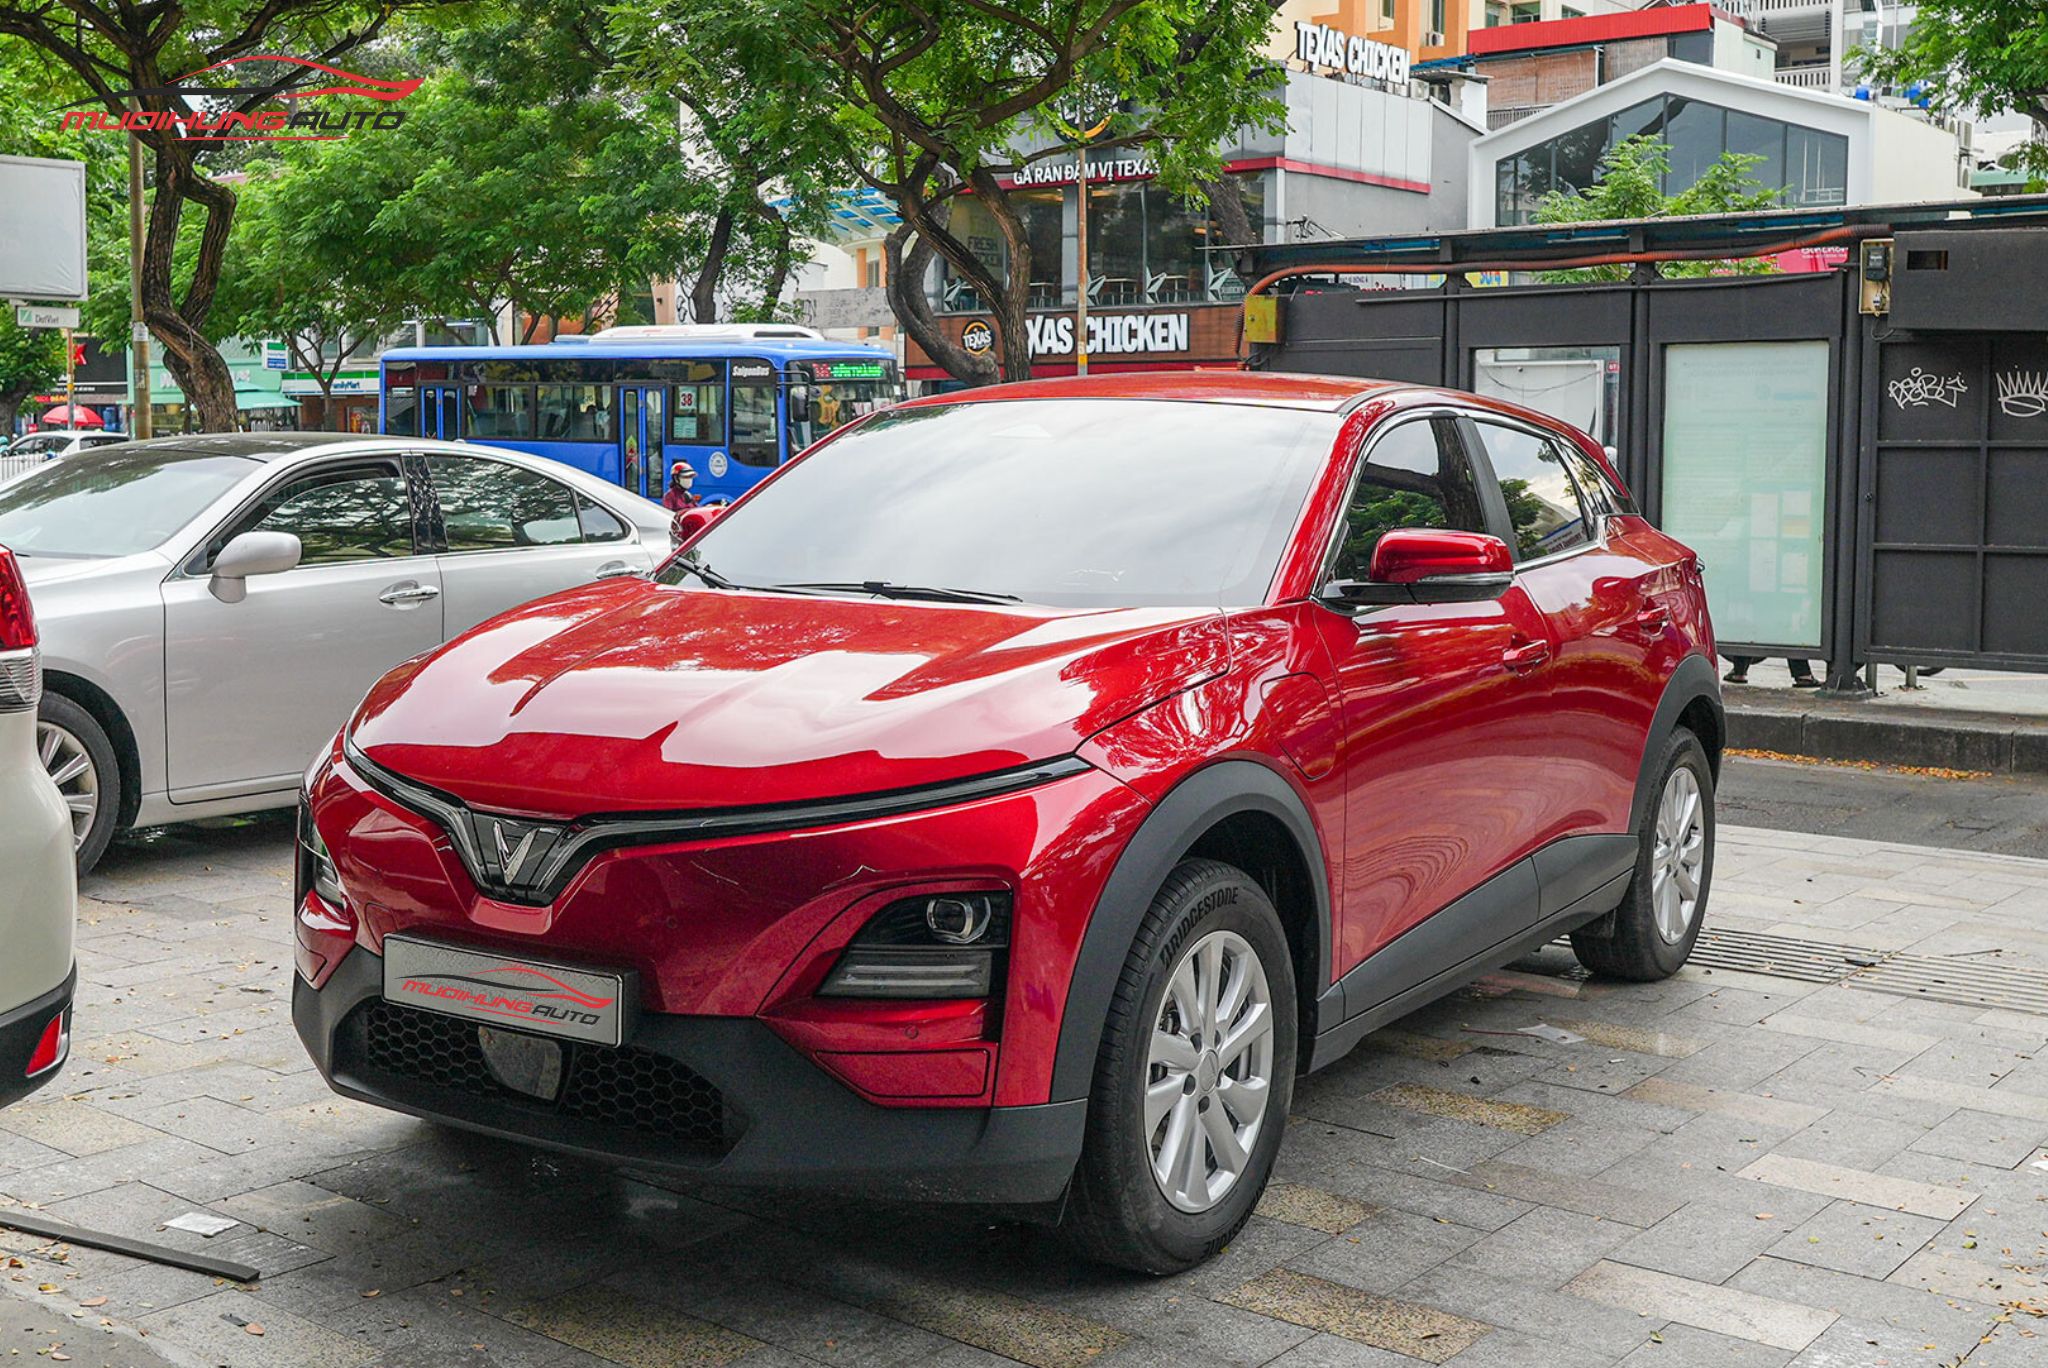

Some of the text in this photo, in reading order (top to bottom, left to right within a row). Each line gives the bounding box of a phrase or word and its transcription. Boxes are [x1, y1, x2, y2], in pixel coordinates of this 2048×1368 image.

[1296, 20, 1411, 85] TEXAS CHICKEN
[1034, 162, 1062, 183] RÁN
[1098, 161, 1114, 181] VỊ
[962, 331, 992, 349] TEXAS
[1025, 313, 1188, 360] XAS CHICKEN
[681, 393, 693, 407] 38
[1159, 886, 1239, 971] BRIDGESTONE
